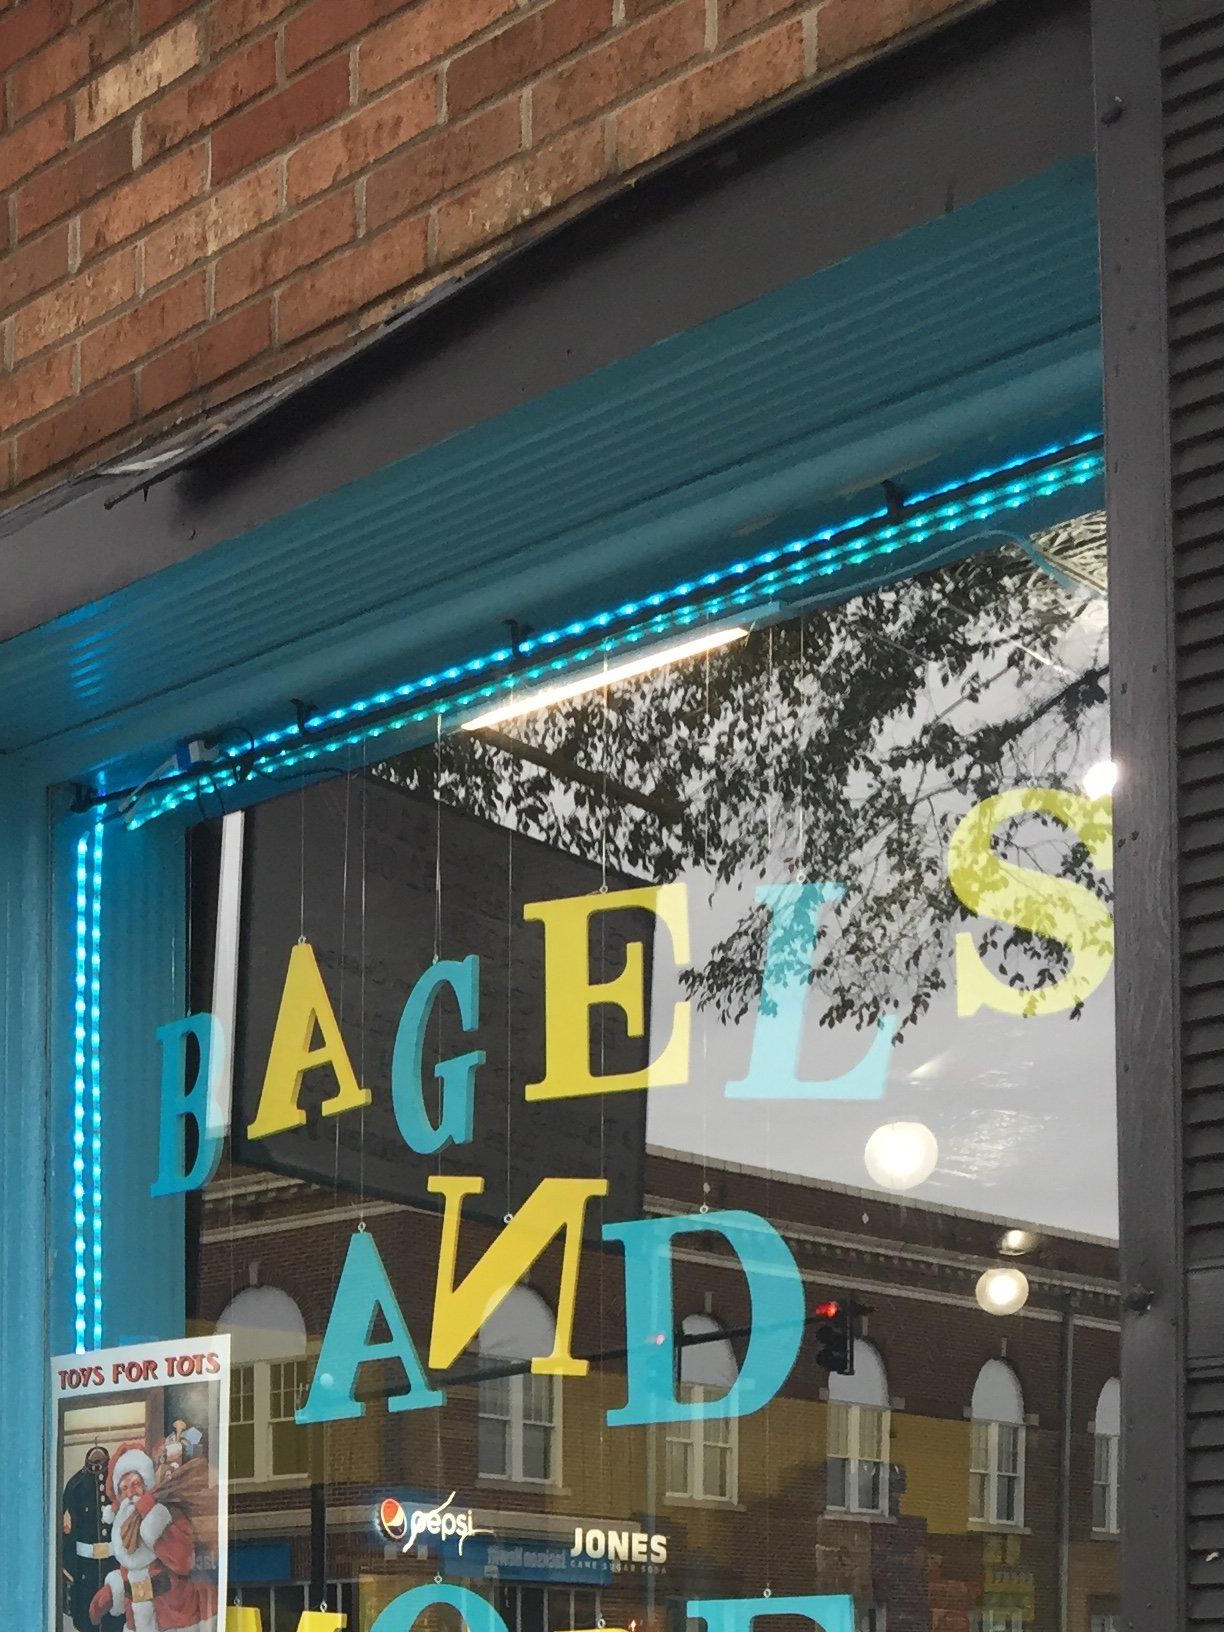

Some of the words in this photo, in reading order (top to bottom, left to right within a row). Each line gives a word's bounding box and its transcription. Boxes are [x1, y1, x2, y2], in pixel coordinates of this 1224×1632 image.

[150, 787, 1115, 1198] BAGELS
[294, 1175, 806, 1427] AND
[58, 1365, 105, 1390] TOYS
[112, 1360, 158, 1384] FOR
[165, 1352, 221, 1377] TOTS
[403, 1498, 481, 1553] pepsi
[570, 1527, 667, 1564] JONES
